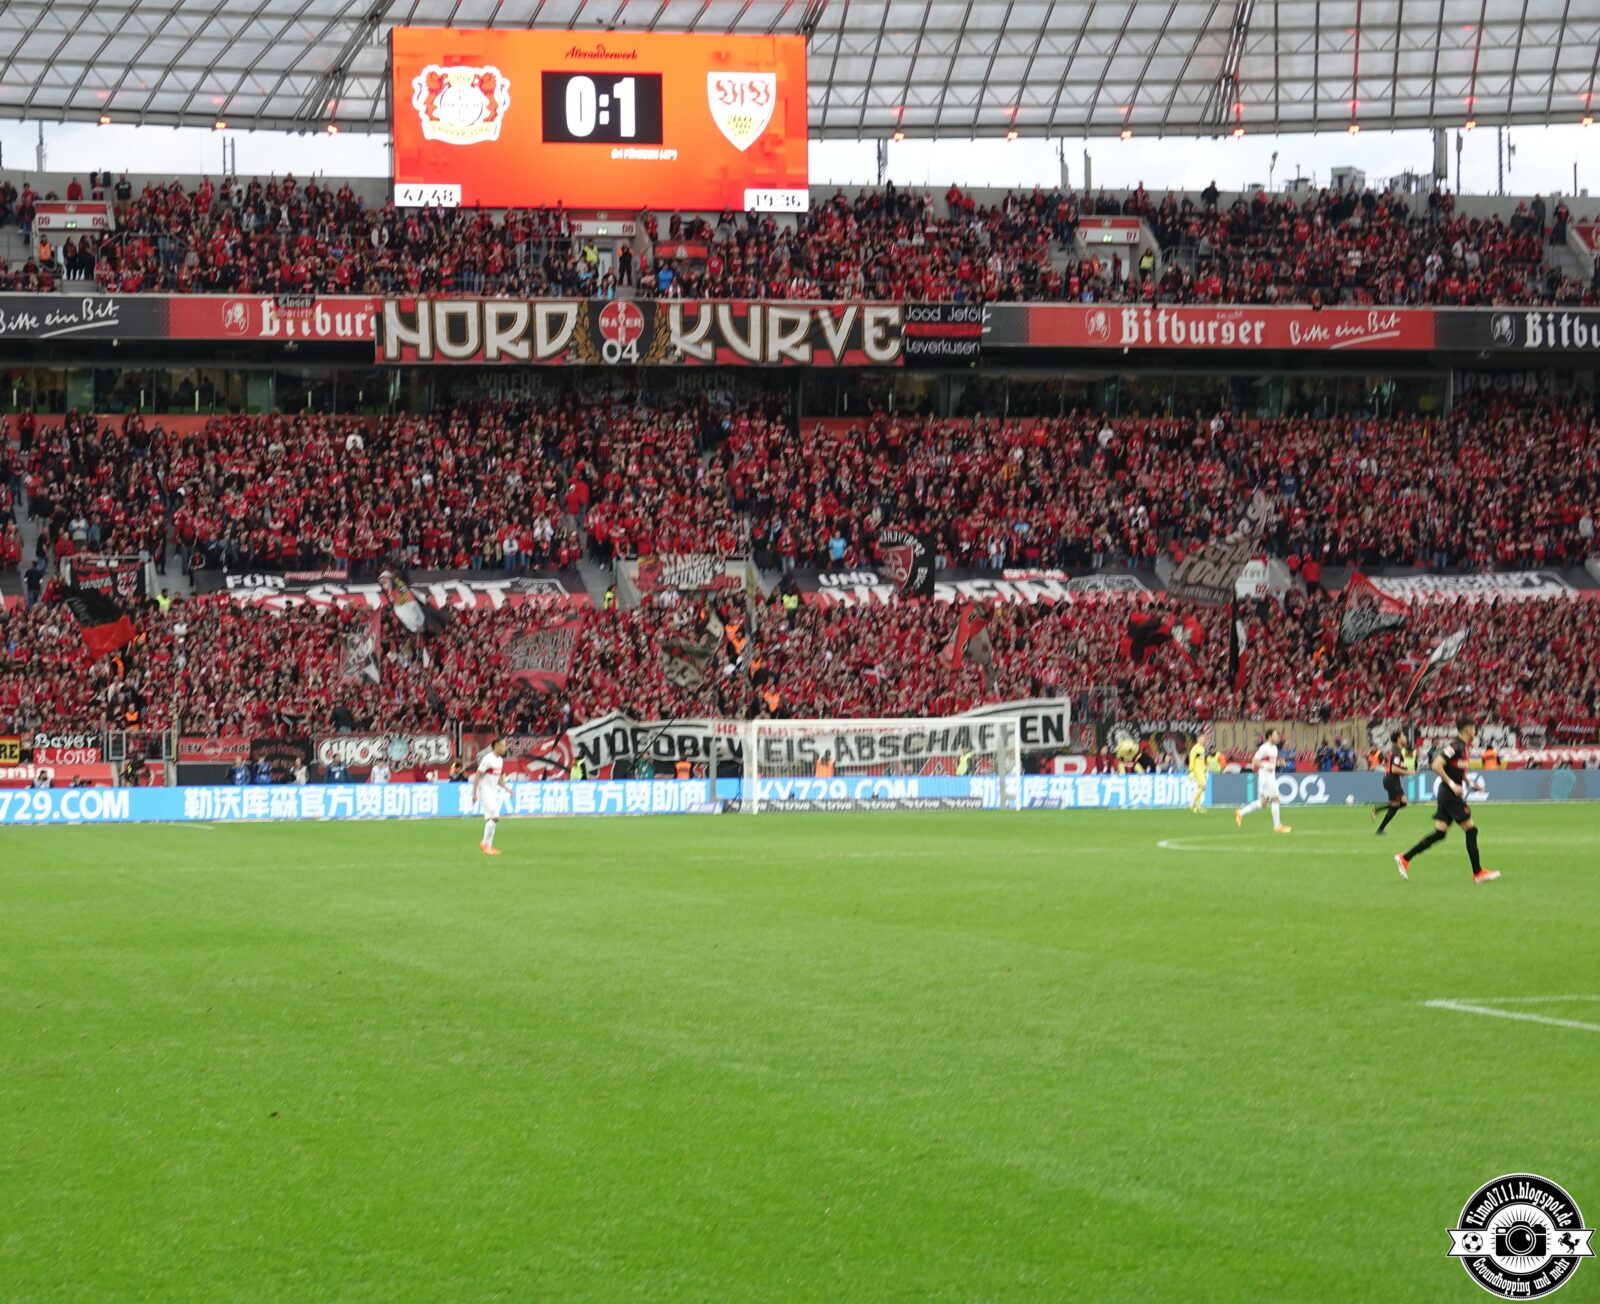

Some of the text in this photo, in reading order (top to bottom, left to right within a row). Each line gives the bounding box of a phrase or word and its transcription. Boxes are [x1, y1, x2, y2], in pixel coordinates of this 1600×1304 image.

[565, 75, 636, 138] 0:1
[44, 309, 79, 326] ein
[1120, 308, 1265, 345] Bitburger
[384, 301, 902, 362] NORD KURVE
[1290, 320, 1329, 345] Bitte
[1335, 320, 1364, 337] ein
[601, 338, 640, 364] 04
[225, 574, 285, 589] FÜR
[34, 734, 97, 749] Bayer
[184, 784, 439, 818] 勒沃库森官方赞助商
